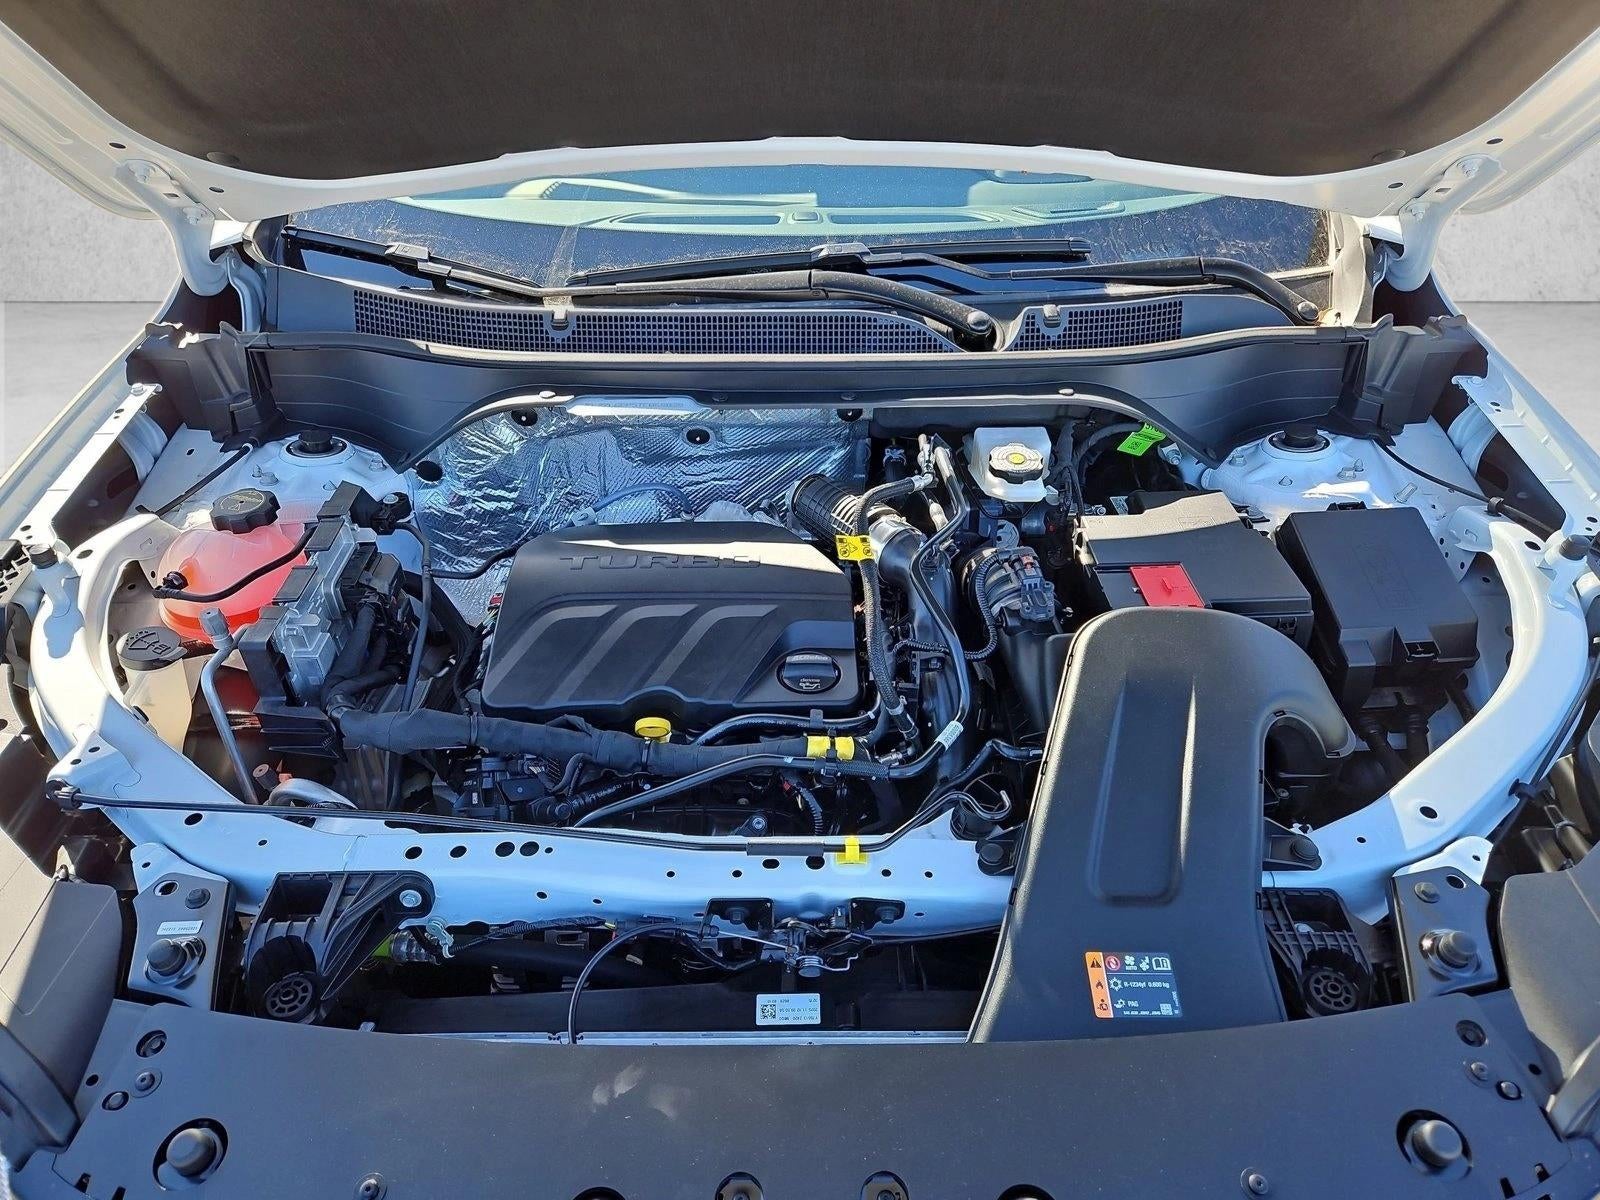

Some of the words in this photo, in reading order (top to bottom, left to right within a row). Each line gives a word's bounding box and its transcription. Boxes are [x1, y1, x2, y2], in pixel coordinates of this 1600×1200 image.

[560, 555, 761, 570] TURBO
[1123, 981, 1146, 989] R-1234yf
[1162, 981, 1170, 989] kg
[1127, 1000, 1139, 1008] PAG
